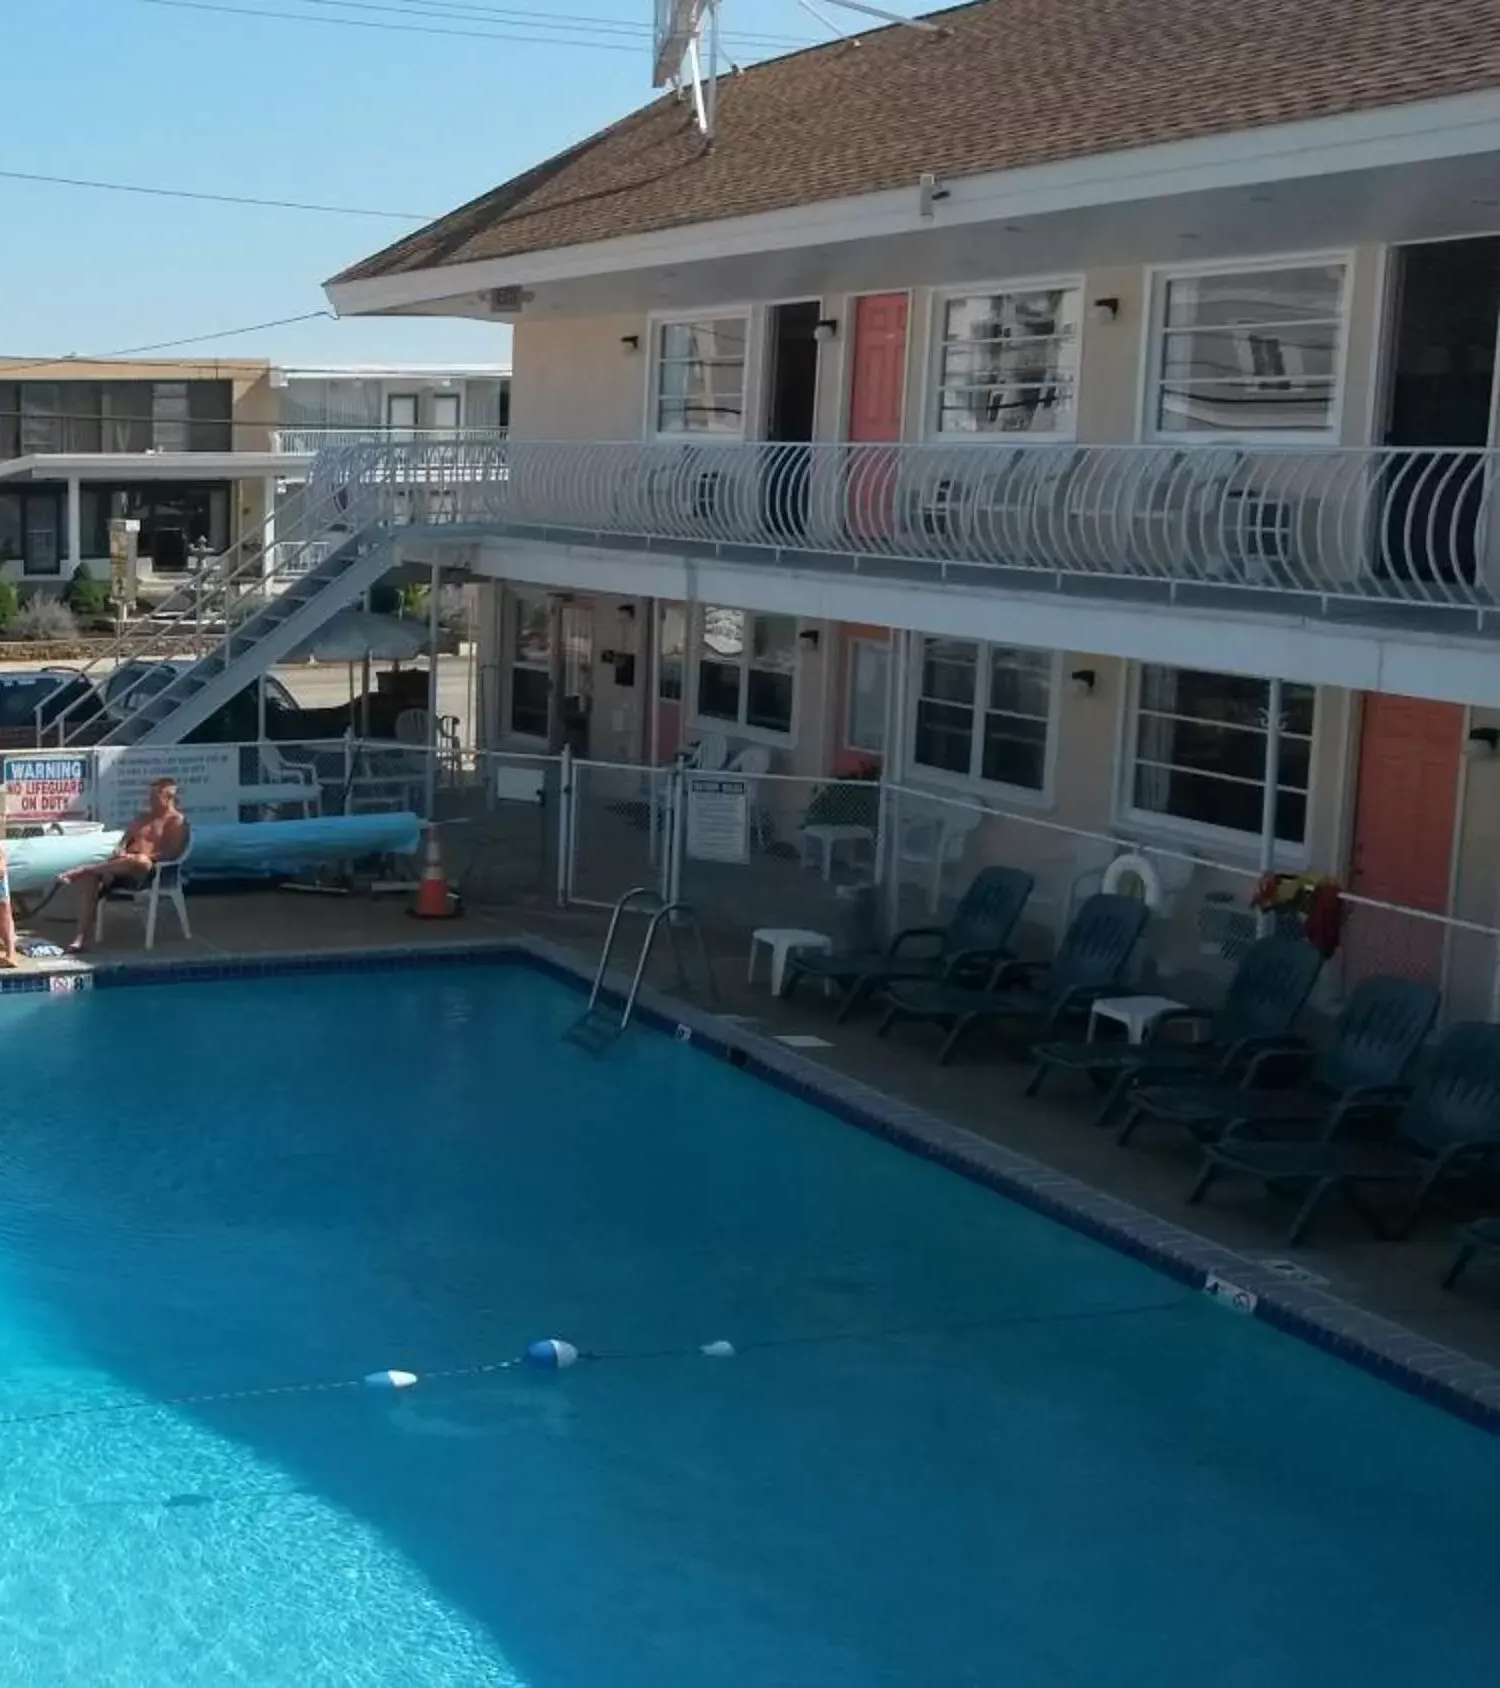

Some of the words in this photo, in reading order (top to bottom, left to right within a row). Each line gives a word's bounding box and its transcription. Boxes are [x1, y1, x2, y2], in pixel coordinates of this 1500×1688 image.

[11, 762, 81, 779] WARNING
[7, 782, 22, 795] NO
[26, 780, 84, 795] LIFEGUARD
[21, 797, 38, 810] ON
[41, 797, 69, 810] DUTY
